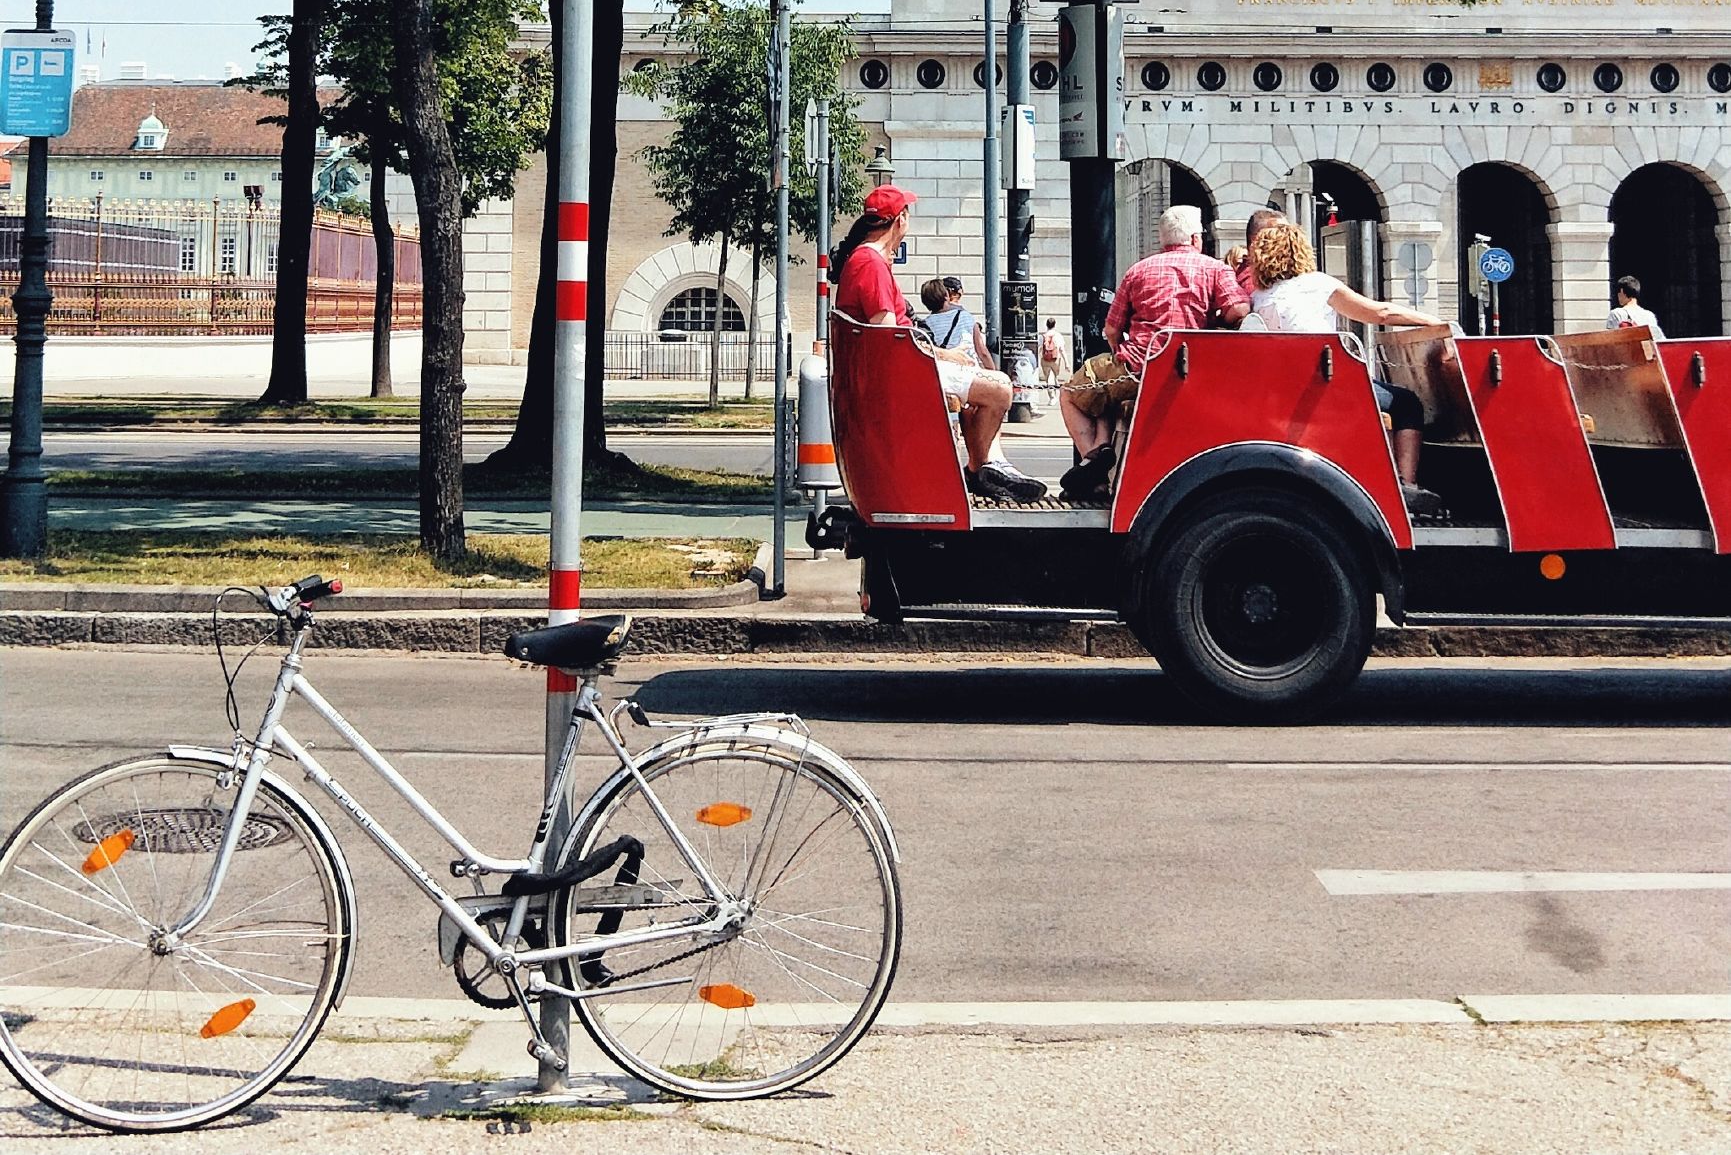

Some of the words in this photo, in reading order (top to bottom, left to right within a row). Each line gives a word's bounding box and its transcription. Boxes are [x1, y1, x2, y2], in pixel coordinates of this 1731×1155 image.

[16, 55, 28, 70] P
[1003, 285, 1035, 293] mumok
[338, 794, 372, 828] PUCH
